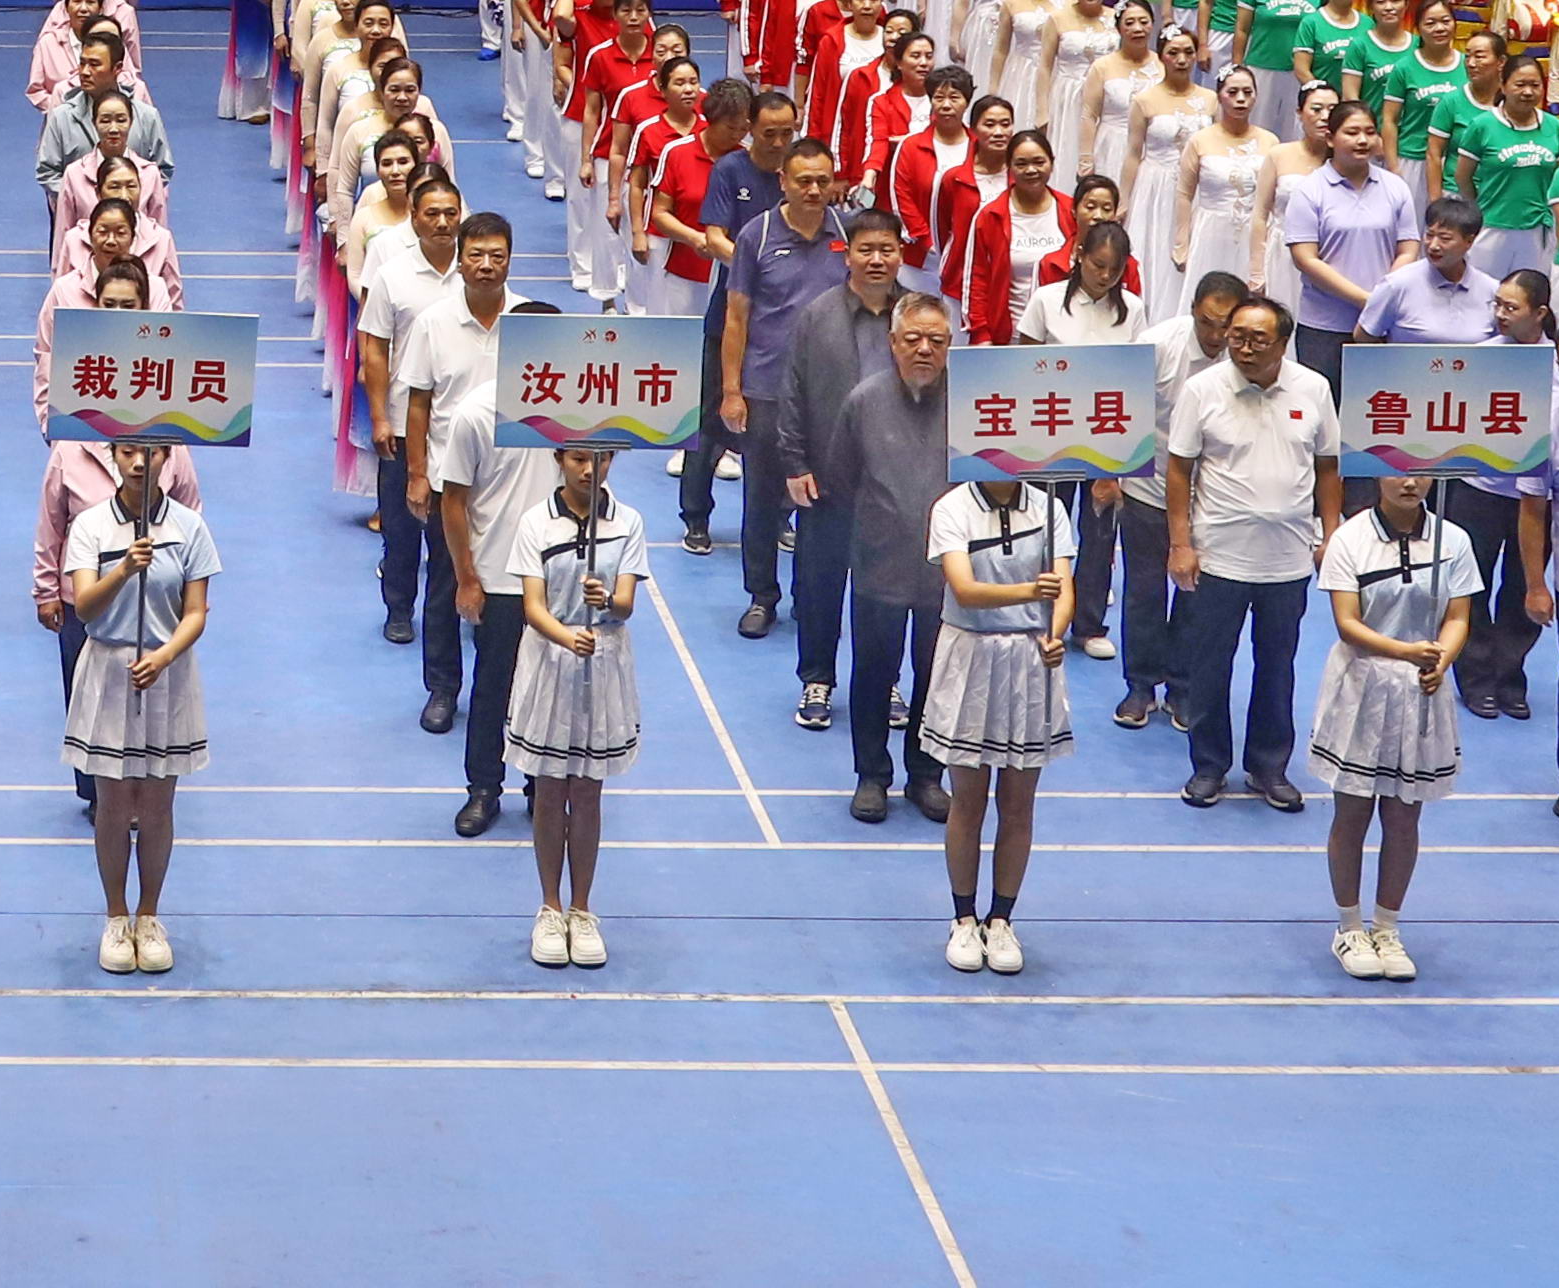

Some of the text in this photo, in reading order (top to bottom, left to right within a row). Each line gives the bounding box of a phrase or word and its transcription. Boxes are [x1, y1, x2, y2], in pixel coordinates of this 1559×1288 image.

[72, 354, 230, 404] 裁判员
[521, 362, 679, 406] 汝州市
[974, 390, 1133, 437] 宝丰县
[1366, 390, 1529, 436] 鲁山县
